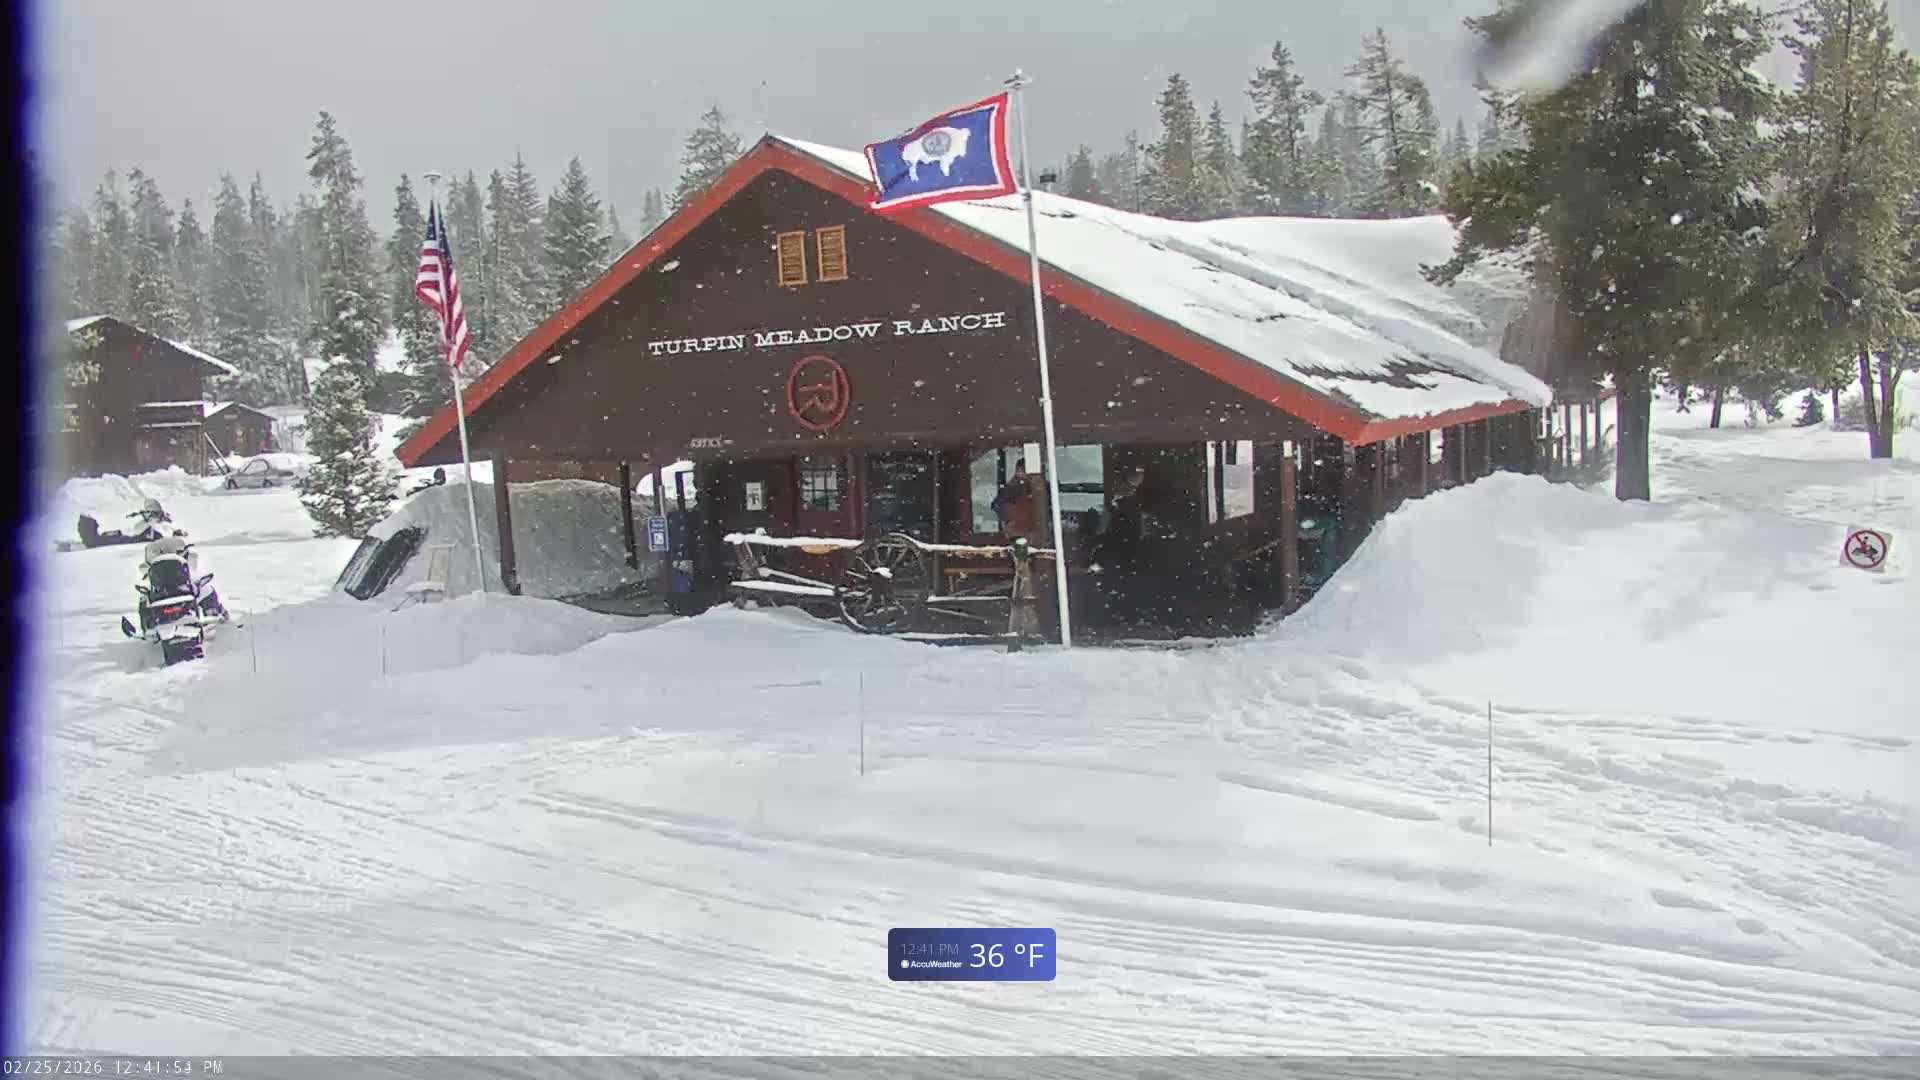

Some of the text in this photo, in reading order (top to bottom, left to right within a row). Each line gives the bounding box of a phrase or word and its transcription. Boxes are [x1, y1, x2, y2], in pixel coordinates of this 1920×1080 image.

[649, 312, 1006, 356] TURPIN MEADOW RANCH
